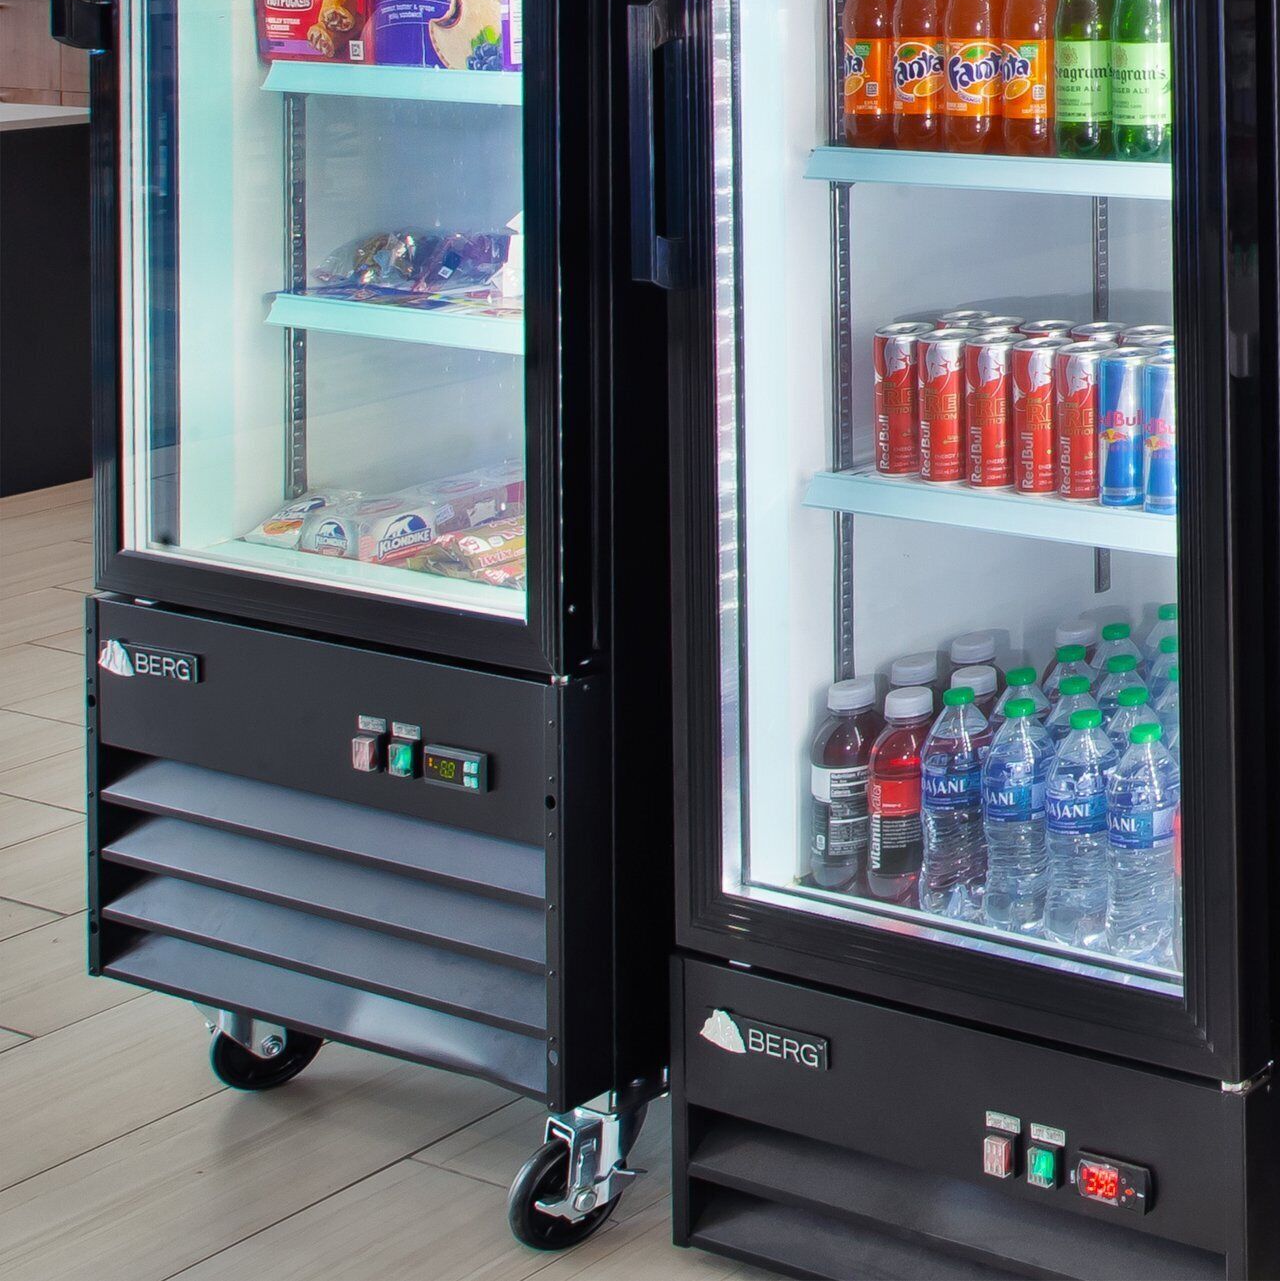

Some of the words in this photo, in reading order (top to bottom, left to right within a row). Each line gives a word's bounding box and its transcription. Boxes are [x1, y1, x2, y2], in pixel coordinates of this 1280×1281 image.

[879, 415, 889, 441] Bull
[880, 443, 889, 469] Red
[1021, 431, 1033, 460] Bull
[1021, 462, 1034, 489] Red
[377, 529, 431, 558] KLONDIKE
[135, 654, 189, 679] BERG
[749, 1030, 819, 1068] BERG
